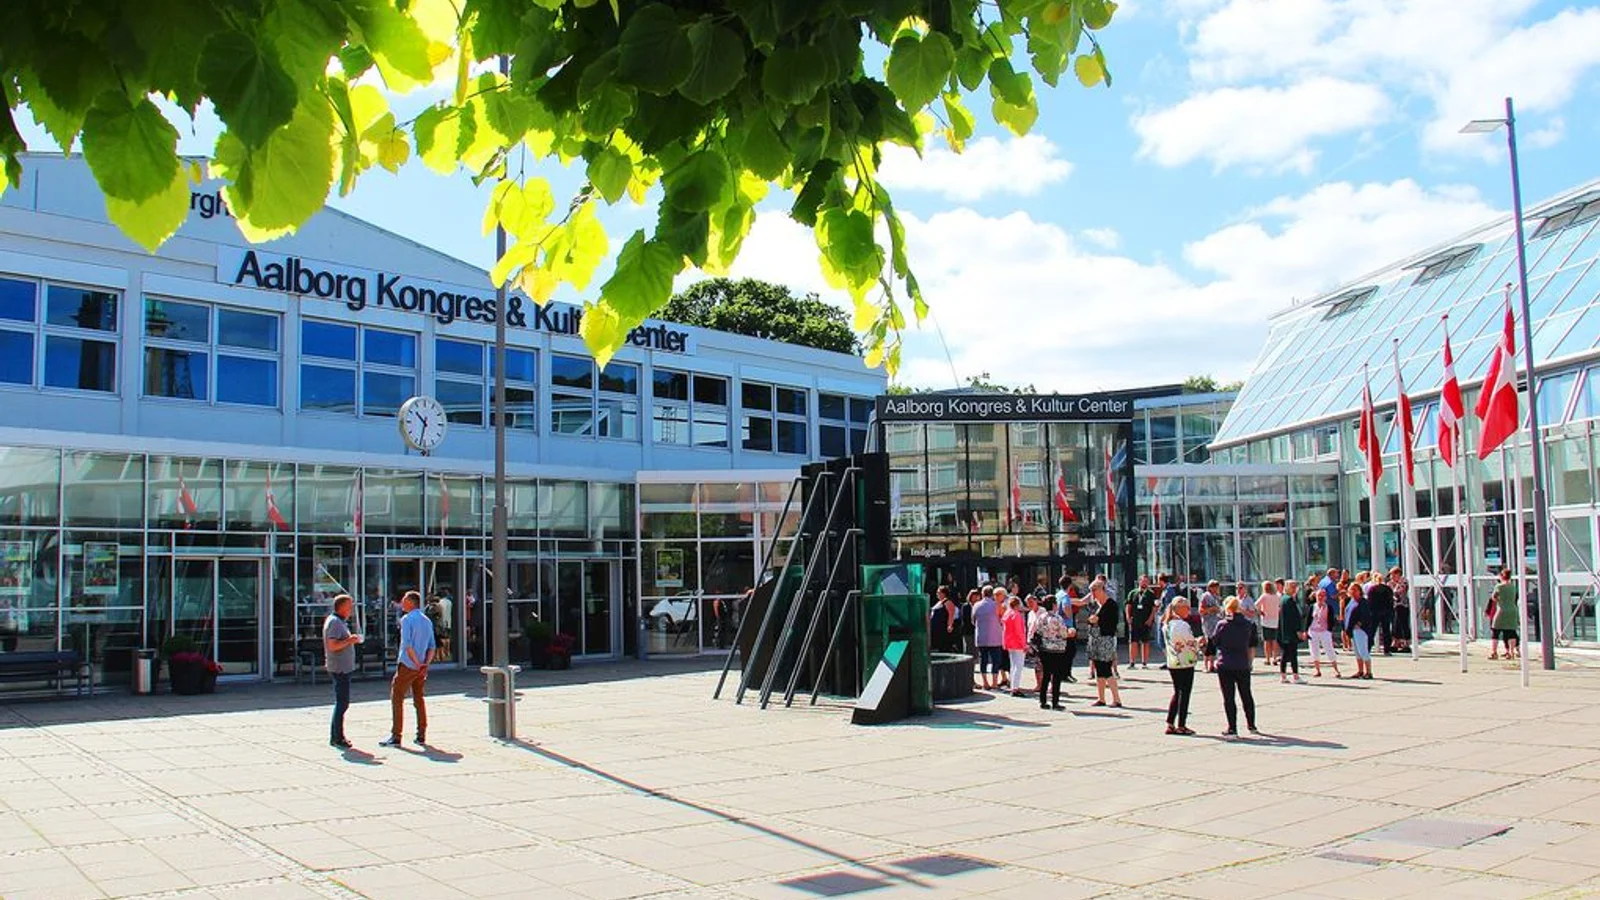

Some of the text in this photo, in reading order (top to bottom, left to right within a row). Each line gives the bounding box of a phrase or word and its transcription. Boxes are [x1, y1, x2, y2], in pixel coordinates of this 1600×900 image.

[235, 250, 689, 352] Aalborg Kongres & Kult enter
[885, 398, 1128, 417] Aalborg Kongres & Kultur Center
